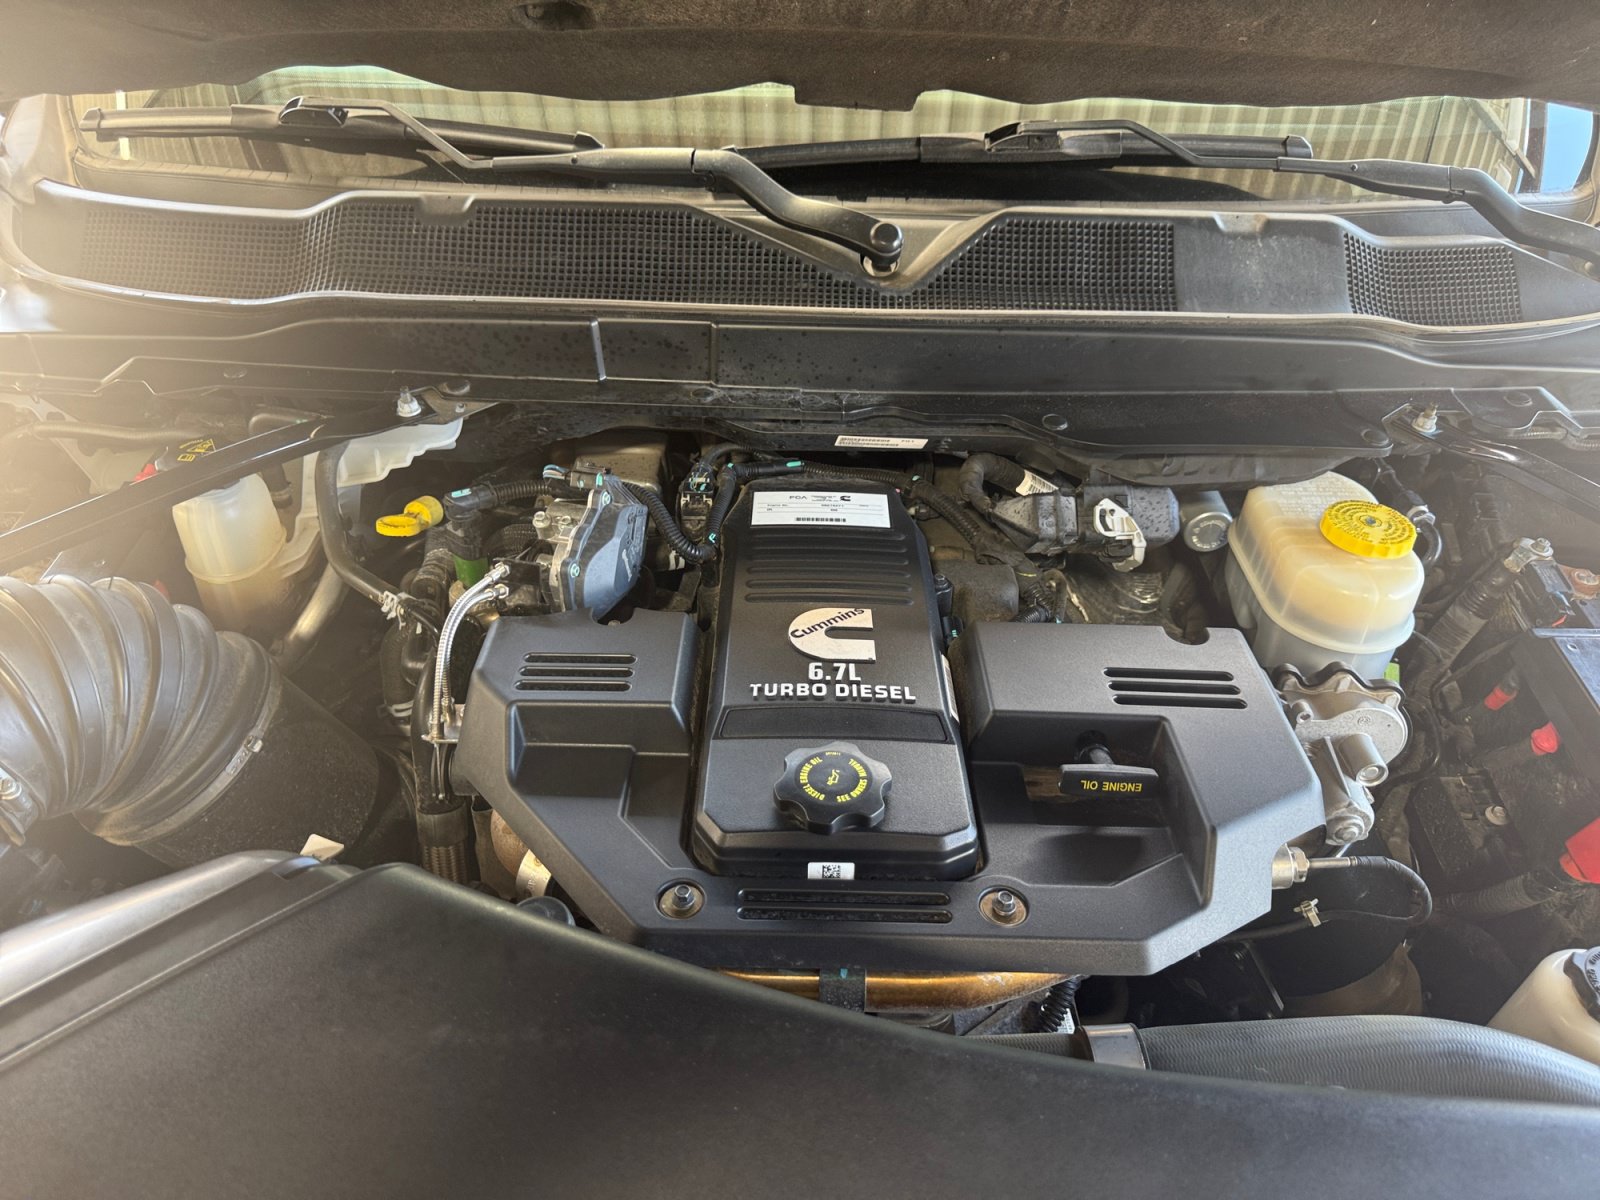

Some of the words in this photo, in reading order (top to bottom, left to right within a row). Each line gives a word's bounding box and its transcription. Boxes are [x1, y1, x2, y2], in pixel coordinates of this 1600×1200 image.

[790, 608, 865, 638] Cummins
[808, 662, 861, 681] 6.7L
[750, 683, 828, 698] TURBO
[835, 683, 916, 700] DIESEL
[803, 784, 825, 801] DIESEL
[1080, 780, 1098, 790] OIL
[1102, 782, 1143, 792] ENGINE
[836, 795, 851, 803] SEE
